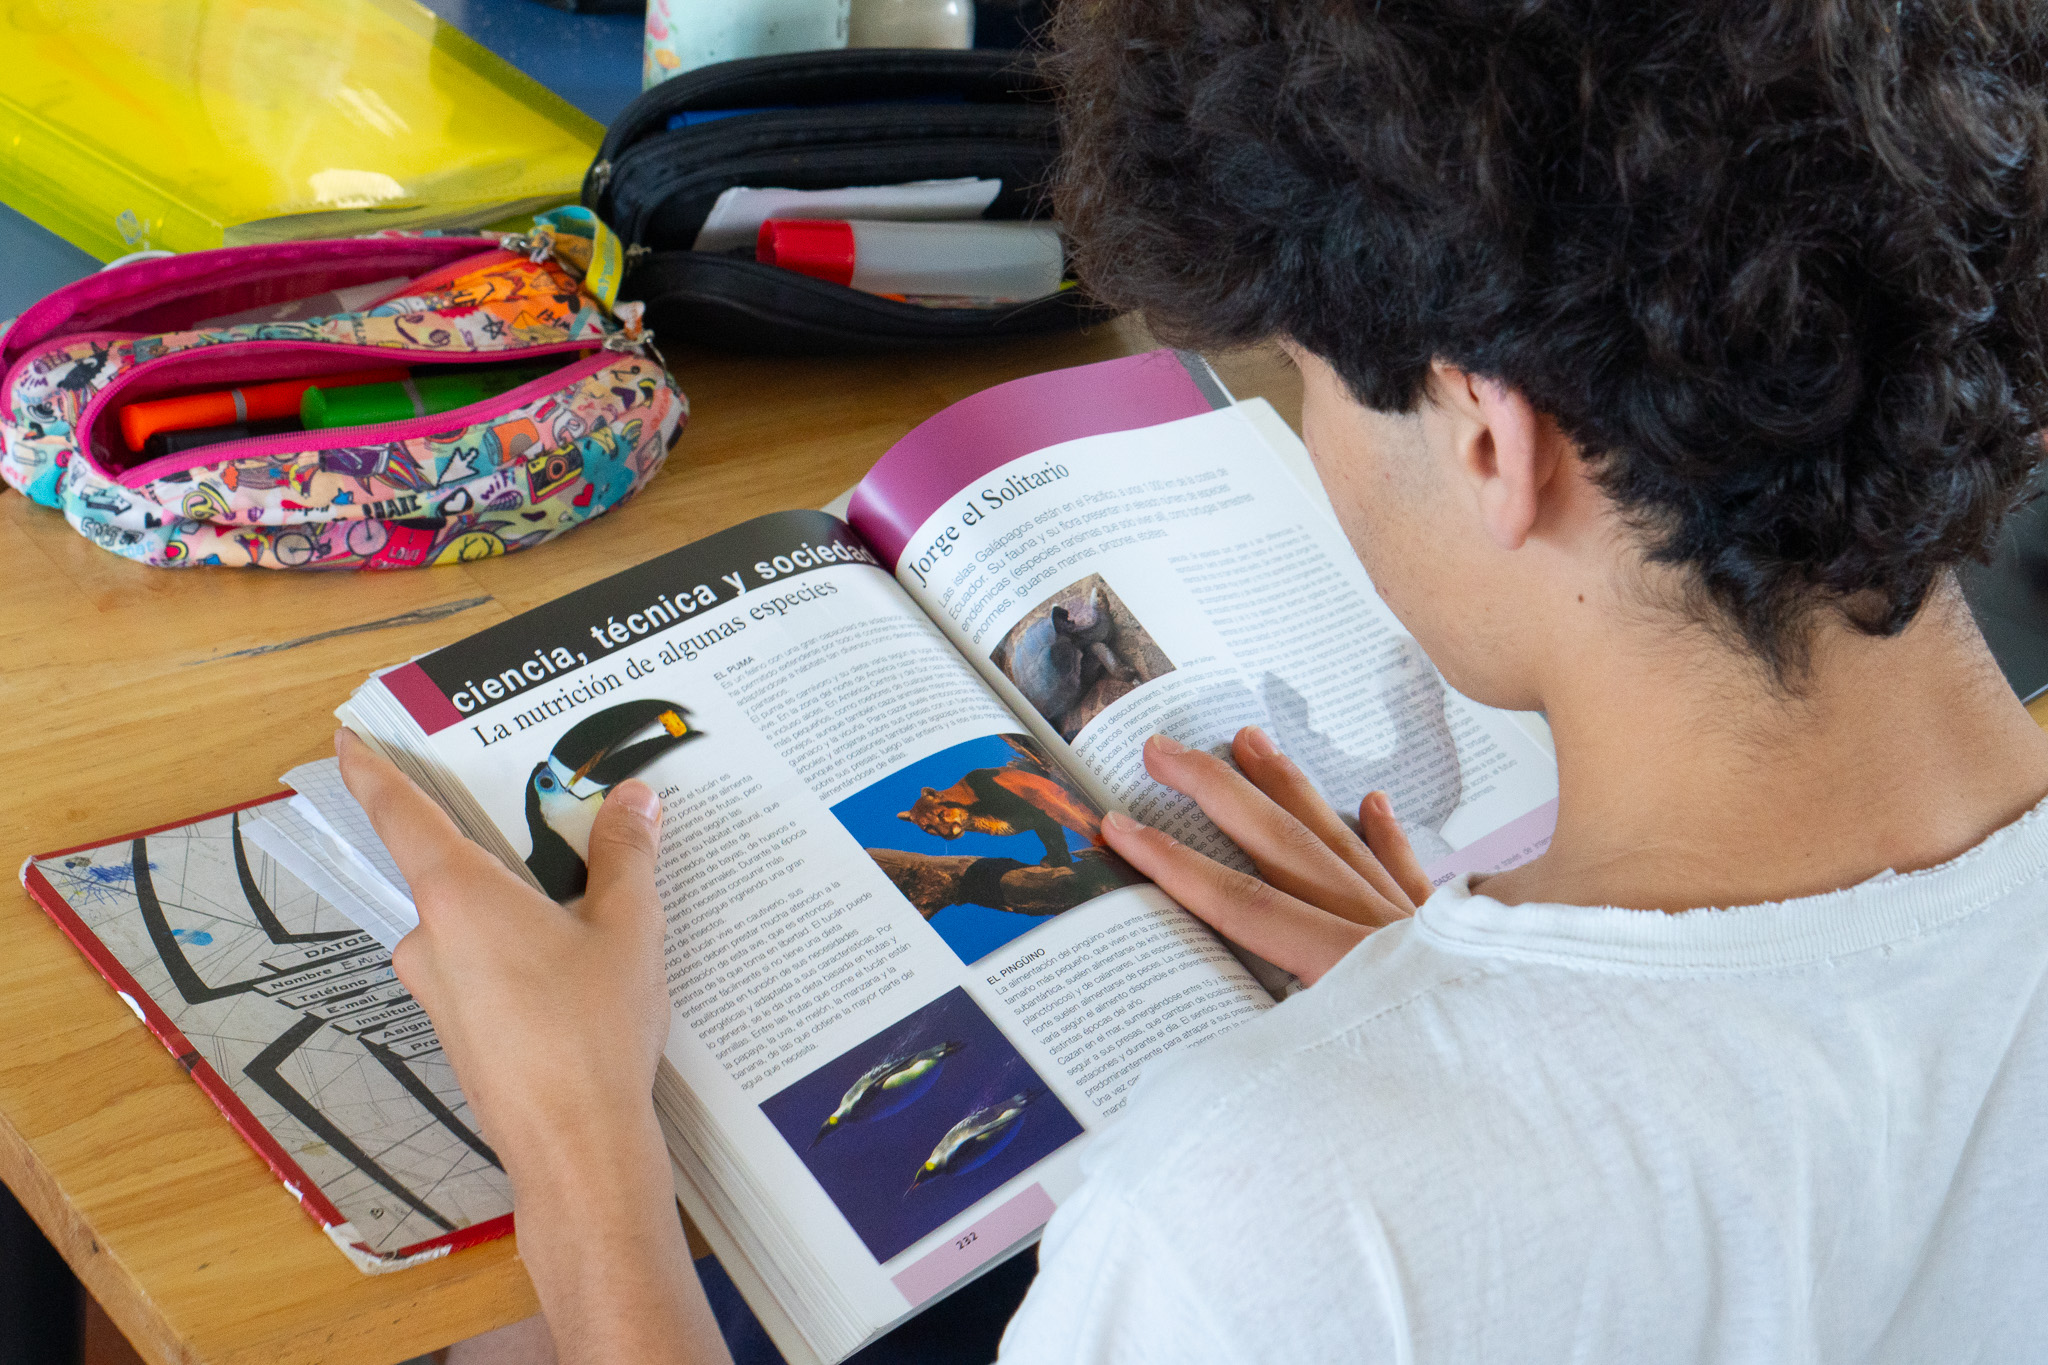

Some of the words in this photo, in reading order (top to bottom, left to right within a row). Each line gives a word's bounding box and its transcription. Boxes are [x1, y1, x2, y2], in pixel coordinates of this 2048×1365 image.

[908, 525, 960, 588] Jorge
[962, 502, 986, 527] el
[981, 461, 1070, 510] Solitario
[937, 586, 954, 608] Las
[953, 562, 976, 587] islas
[974, 521, 1034, 562] Galápagos
[1033, 507, 1062, 524] están
[1061, 502, 1076, 512] en
[1075, 497, 1085, 507] el
[948, 574, 988, 620] Ecuador.
[987, 558, 1006, 574] Su
[1004, 538, 1038, 561] fauna
[1036, 533, 1046, 544] y
[1045, 526, 1060, 537] su
[1058, 517, 1082, 530] flora
[961, 576, 1011, 632] endémicas
[1009, 544, 1061, 579] (especies
[972, 598, 1015, 644] enormes,
[1012, 565, 1057, 597] iguanas
[1056, 547, 1099, 569] marinas,
[452, 646, 589, 713] ciencia,
[590, 584, 718, 649] técnica
[721, 571, 747, 596] y
[754, 539, 878, 580] sociedad
[471, 723, 512, 747] La
[513, 674, 624, 731] nutrición
[626, 657, 655, 680] de
[658, 616, 747, 666] algunas
[749, 581, 838, 621] especies
[713, 671, 728, 682] EL
[727, 656, 755, 674] PUMA
[1075, 733, 1097, 757] Desde
[1096, 723, 1108, 734] su
[1107, 689, 1161, 725] descubrimiento,
[1085, 752, 1096, 768] por
[1095, 728, 1122, 752] barcos
[1093, 764, 1103, 775] de
[1100, 744, 1122, 765] focas
[1121, 739, 1128, 747] y
[1127, 722, 1153, 743] piratas
[1152, 716, 1163, 725] en
[811, 776, 834, 792] sobre
[834, 768, 850, 779] sus
[818, 767, 875, 801] alimentándose
[875, 761, 887, 769] de
[1102, 747, 1141, 785] despensas,
[1110, 782, 1120, 794] da
[1117, 761, 1142, 783] fresca
[658, 784, 680, 800] CÁN
[1117, 780, 1141, 803] hierba
[1127, 781, 1158, 813] especies
[1146, 809, 1164, 827] uido
[1164, 800, 1175, 810] de
[1182, 818, 1192, 828] el
[304, 934, 373, 959] DATOS
[673, 988, 704, 1008] distinta
[704, 981, 717, 990] de
[715, 975, 726, 984] la
[726, 966, 743, 978] que
[742, 952, 766, 968] toma
[766, 946, 778, 955] en
[777, 926, 809, 948] libertad.
[810, 919, 821, 929] El
[820, 907, 846, 923] tucán
[845, 892, 872, 911] puede
[986, 975, 1001, 985] EL
[999, 948, 1045, 977] PINGÜINO
[994, 985, 1008, 995] La
[1008, 957, 1058, 988] alimentación
[1057, 948, 1071, 959] del
[1071, 932, 1105, 954] pingüino
[1104, 923, 1124, 934] varía
[1123, 915, 1143, 926] entre
[270, 968, 332, 990] Nombre
[297, 978, 368, 1002] Teléfono
[705, 1041, 716, 1050] lo
[716, 1021, 750, 1045] general,
[750, 1014, 762, 1024] se
[761, 1009, 771, 1017] le
[771, 1001, 784, 1011] da
[784, 991, 801, 1004] una
[801, 979, 823, 994] dieta
[821, 961, 854, 982] basada
[854, 954, 866, 963] en
[865, 940, 890, 956] frutas
[889, 935, 897, 944] y
[1013, 983, 1065, 1015] subantártica,
[1064, 967, 1092, 985] suelen
[1091, 945, 1135, 970] alimentarse
[1135, 940, 1147, 948] de
[326, 994, 379, 1014] E-mail
[356, 1002, 420, 1026] Instituci
[715, 1037, 751, 1060] semillas.
[750, 1022, 774, 1039] Entre
[773, 1014, 788, 1025] las
[787, 1000, 813, 1016] frutas
[813, 990, 830, 1002] que
[830, 975, 854, 992] come
[854, 968, 864, 978] el
[862, 956, 888, 973] tucán
[887, 942, 911, 958] están
[1048, 1032, 1083, 1055] distintas
[1082, 1015, 1113, 1035] épocas
[1112, 1005, 1127, 1017] del
[1126, 998, 1145, 1010] año.
[1057, 1047, 1084, 1065] Cazan
[1084, 1040, 1096, 1049] en
[1096, 1033, 1105, 1042] el
[1105, 1024, 1124, 1037] mar,
[1123, 992, 1182, 1026] sumergiéndose
[1182, 984, 1202, 995] entre
[1201, 978, 1213, 987] 15
[411, 1039, 440, 1051] Pro
[1084, 1047, 1163, 1098] predominantemente
[1162, 1036, 1182, 1051] para
[1181, 1021, 1209, 1039] atrapar
[1216, 1012, 1231, 1022] sus
[740, 1074, 763, 1090] agua
[763, 1064, 780, 1077] que
[780, 1043, 818, 1067] necesita.
[955, 1231, 978, 1250] 232
